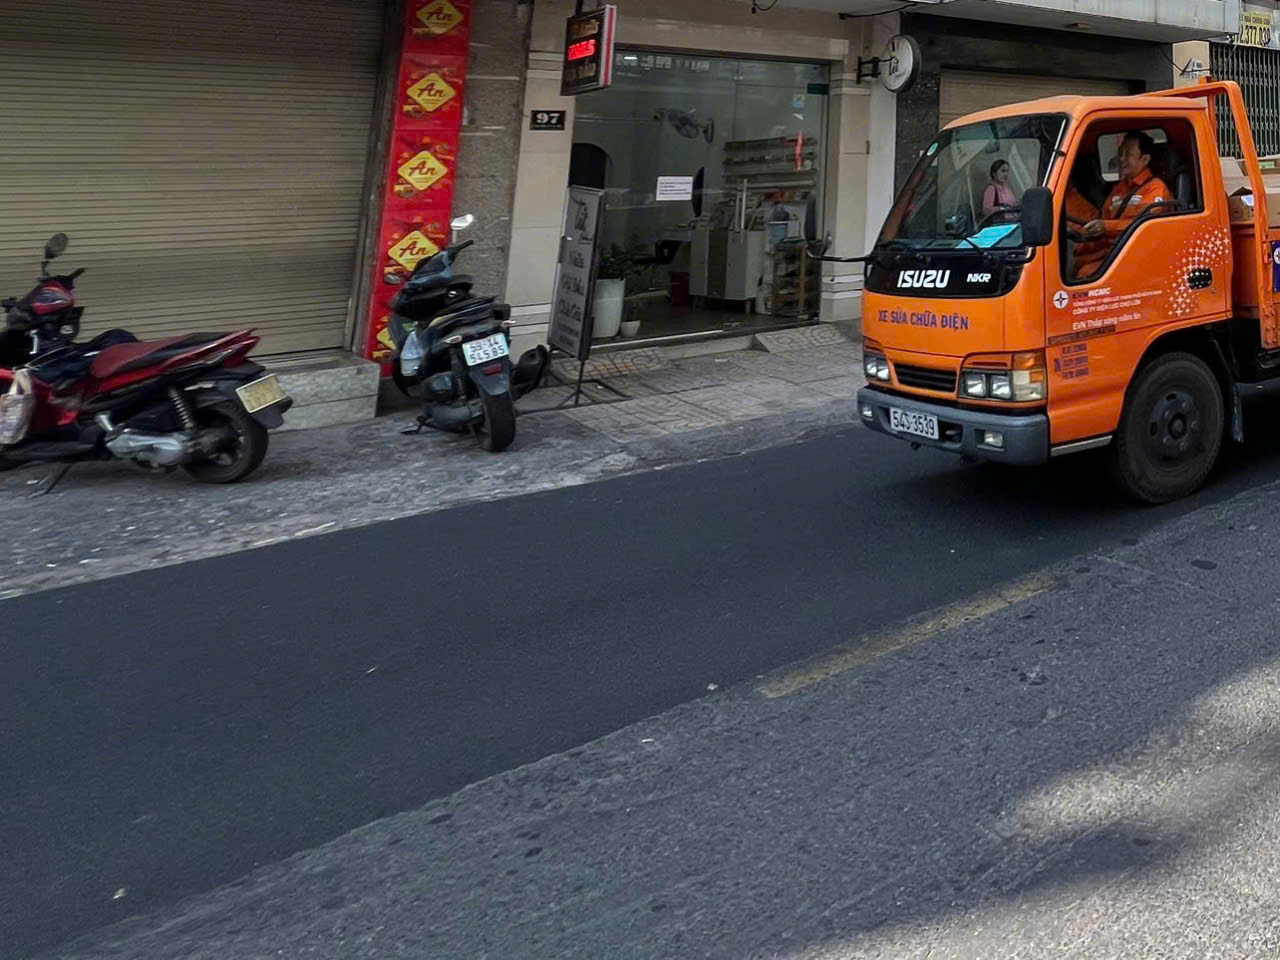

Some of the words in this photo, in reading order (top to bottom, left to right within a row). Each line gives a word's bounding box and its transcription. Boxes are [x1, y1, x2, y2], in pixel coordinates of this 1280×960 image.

[417, 82, 447, 98] An
[536, 112, 560, 124] 97
[409, 160, 438, 177] An
[399, 241, 429, 258] An
[897, 269, 951, 289] ISUZU
[966, 272, 992, 283] NKR
[878, 309, 889, 323] XE
[910, 310, 938, 328] CHỮA
[940, 312, 969, 332] ĐIỆN
